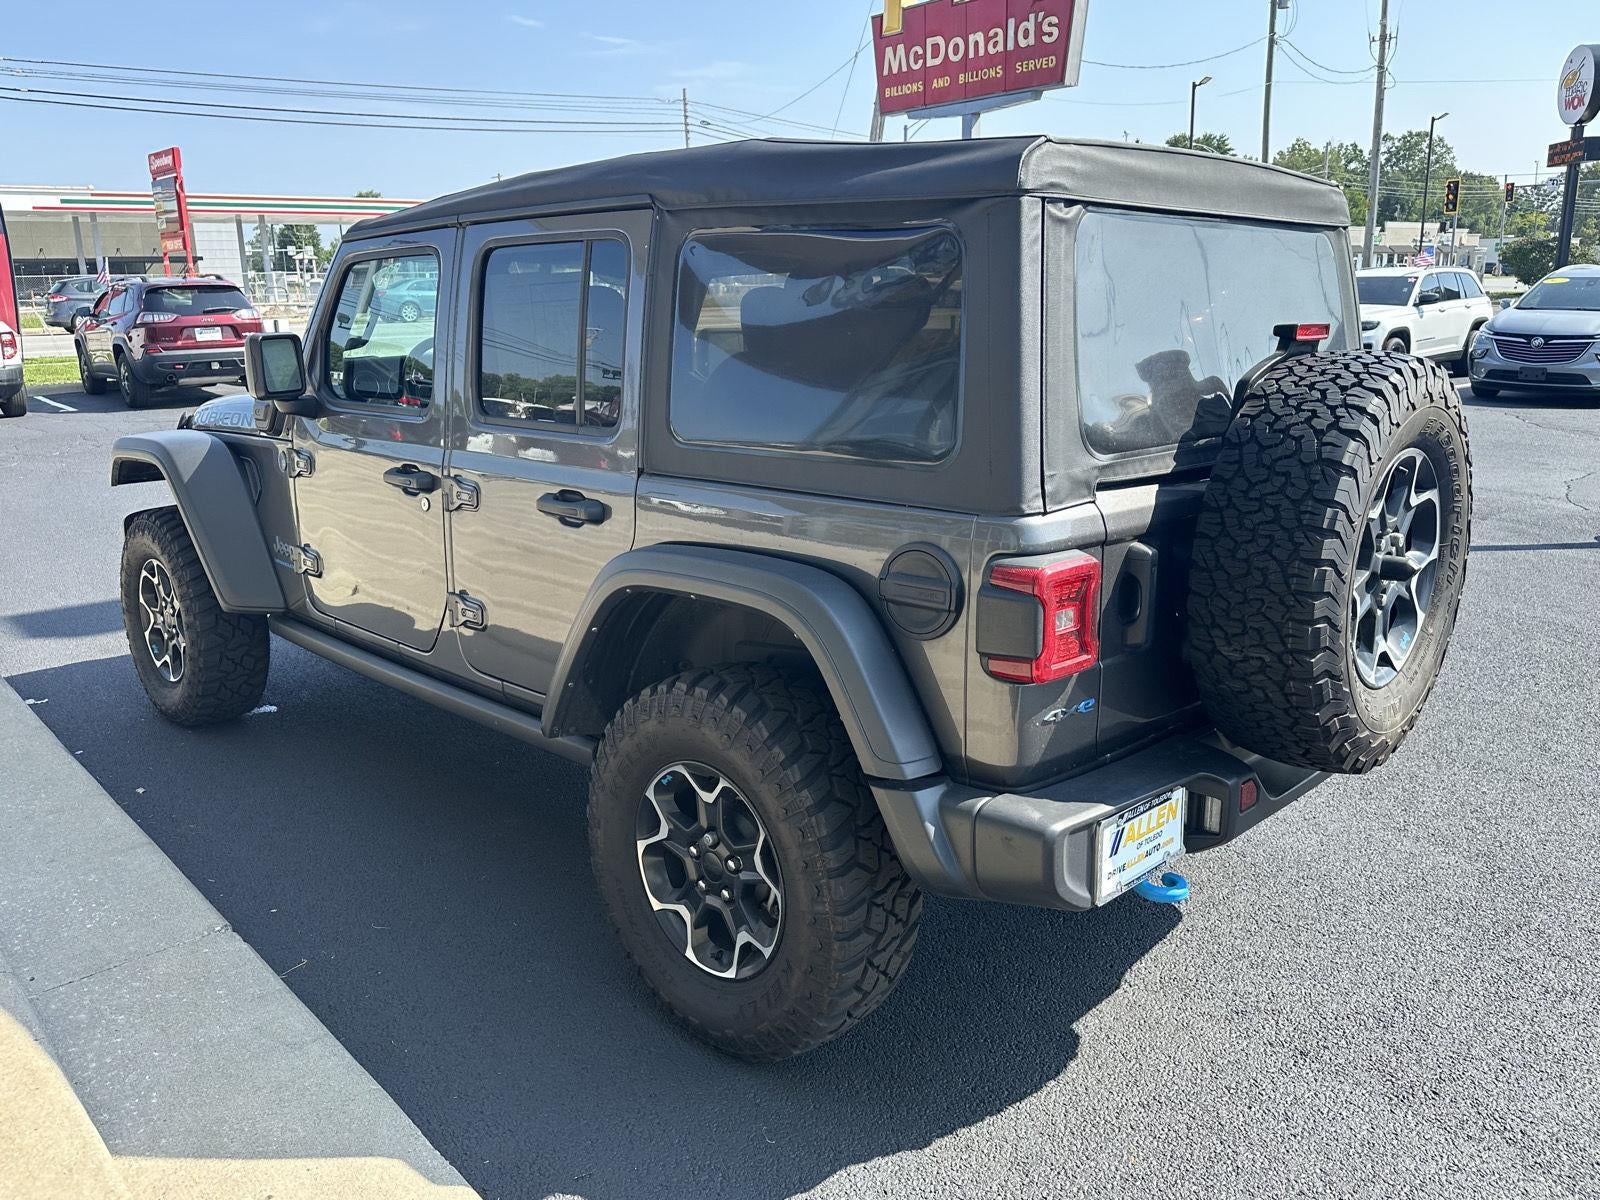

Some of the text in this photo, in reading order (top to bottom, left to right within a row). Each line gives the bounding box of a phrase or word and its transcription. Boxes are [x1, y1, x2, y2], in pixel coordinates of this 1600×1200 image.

[882, 11, 1060, 77] McDonald's
[885, 55, 1057, 98] BILLIONS AND BILLIONS SERVED
[1564, 93, 1586, 111] WOK
[150, 154, 173, 171] Speedway
[1127, 791, 1173, 819] ALLEN OF TOLEDO
[1122, 798, 1179, 848] ALLEN
[1136, 830, 1163, 850] OF TOLEDO
